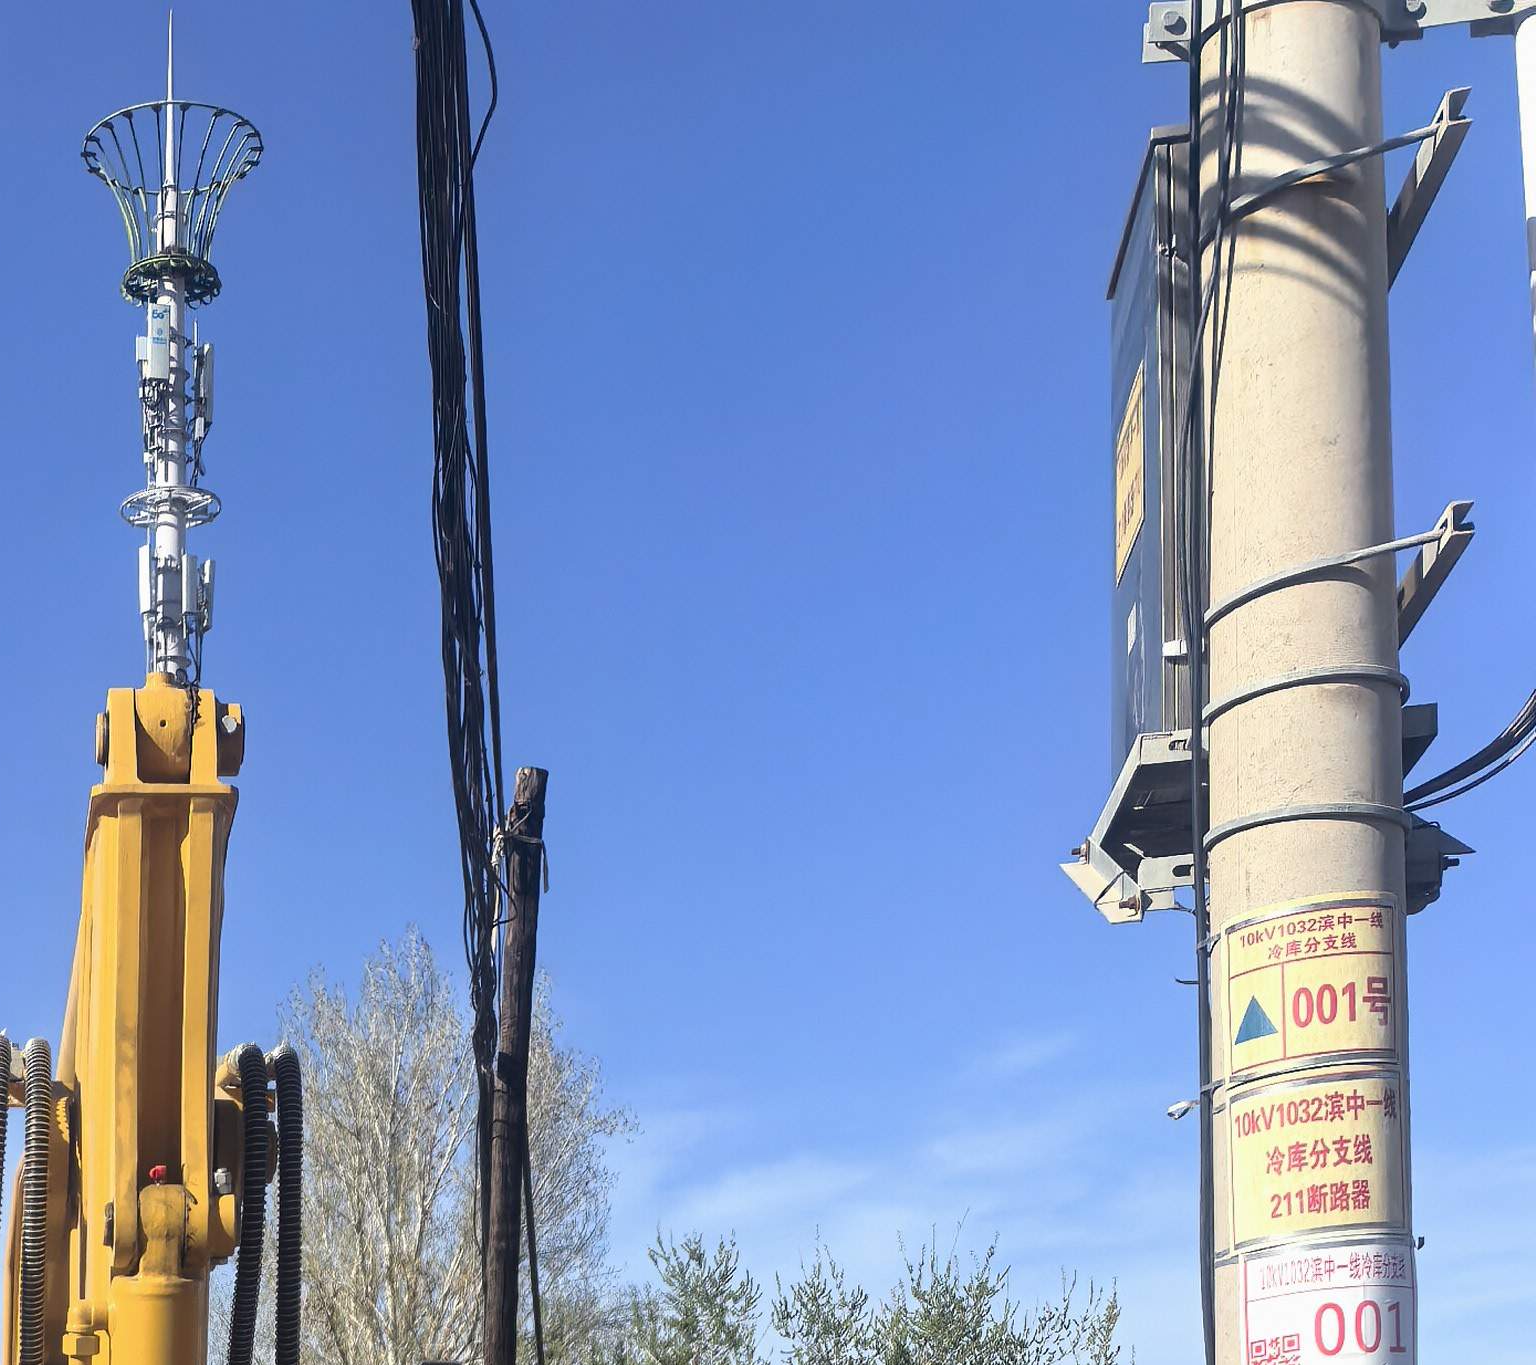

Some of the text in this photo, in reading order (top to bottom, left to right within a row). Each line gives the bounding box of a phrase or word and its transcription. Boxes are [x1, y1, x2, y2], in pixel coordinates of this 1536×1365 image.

[1240, 912, 1384, 948] 10kV1032滨中一线
[1267, 933, 1357, 960] 冷库分支线
[1292, 976, 1391, 1027] 001号
[1234, 1088, 1397, 1139] 10kV1032滨中一线
[1266, 1133, 1373, 1175] 冷库分支线
[1271, 1180, 1371, 1218] 211断路器
[1314, 1299, 1407, 1357] 001
